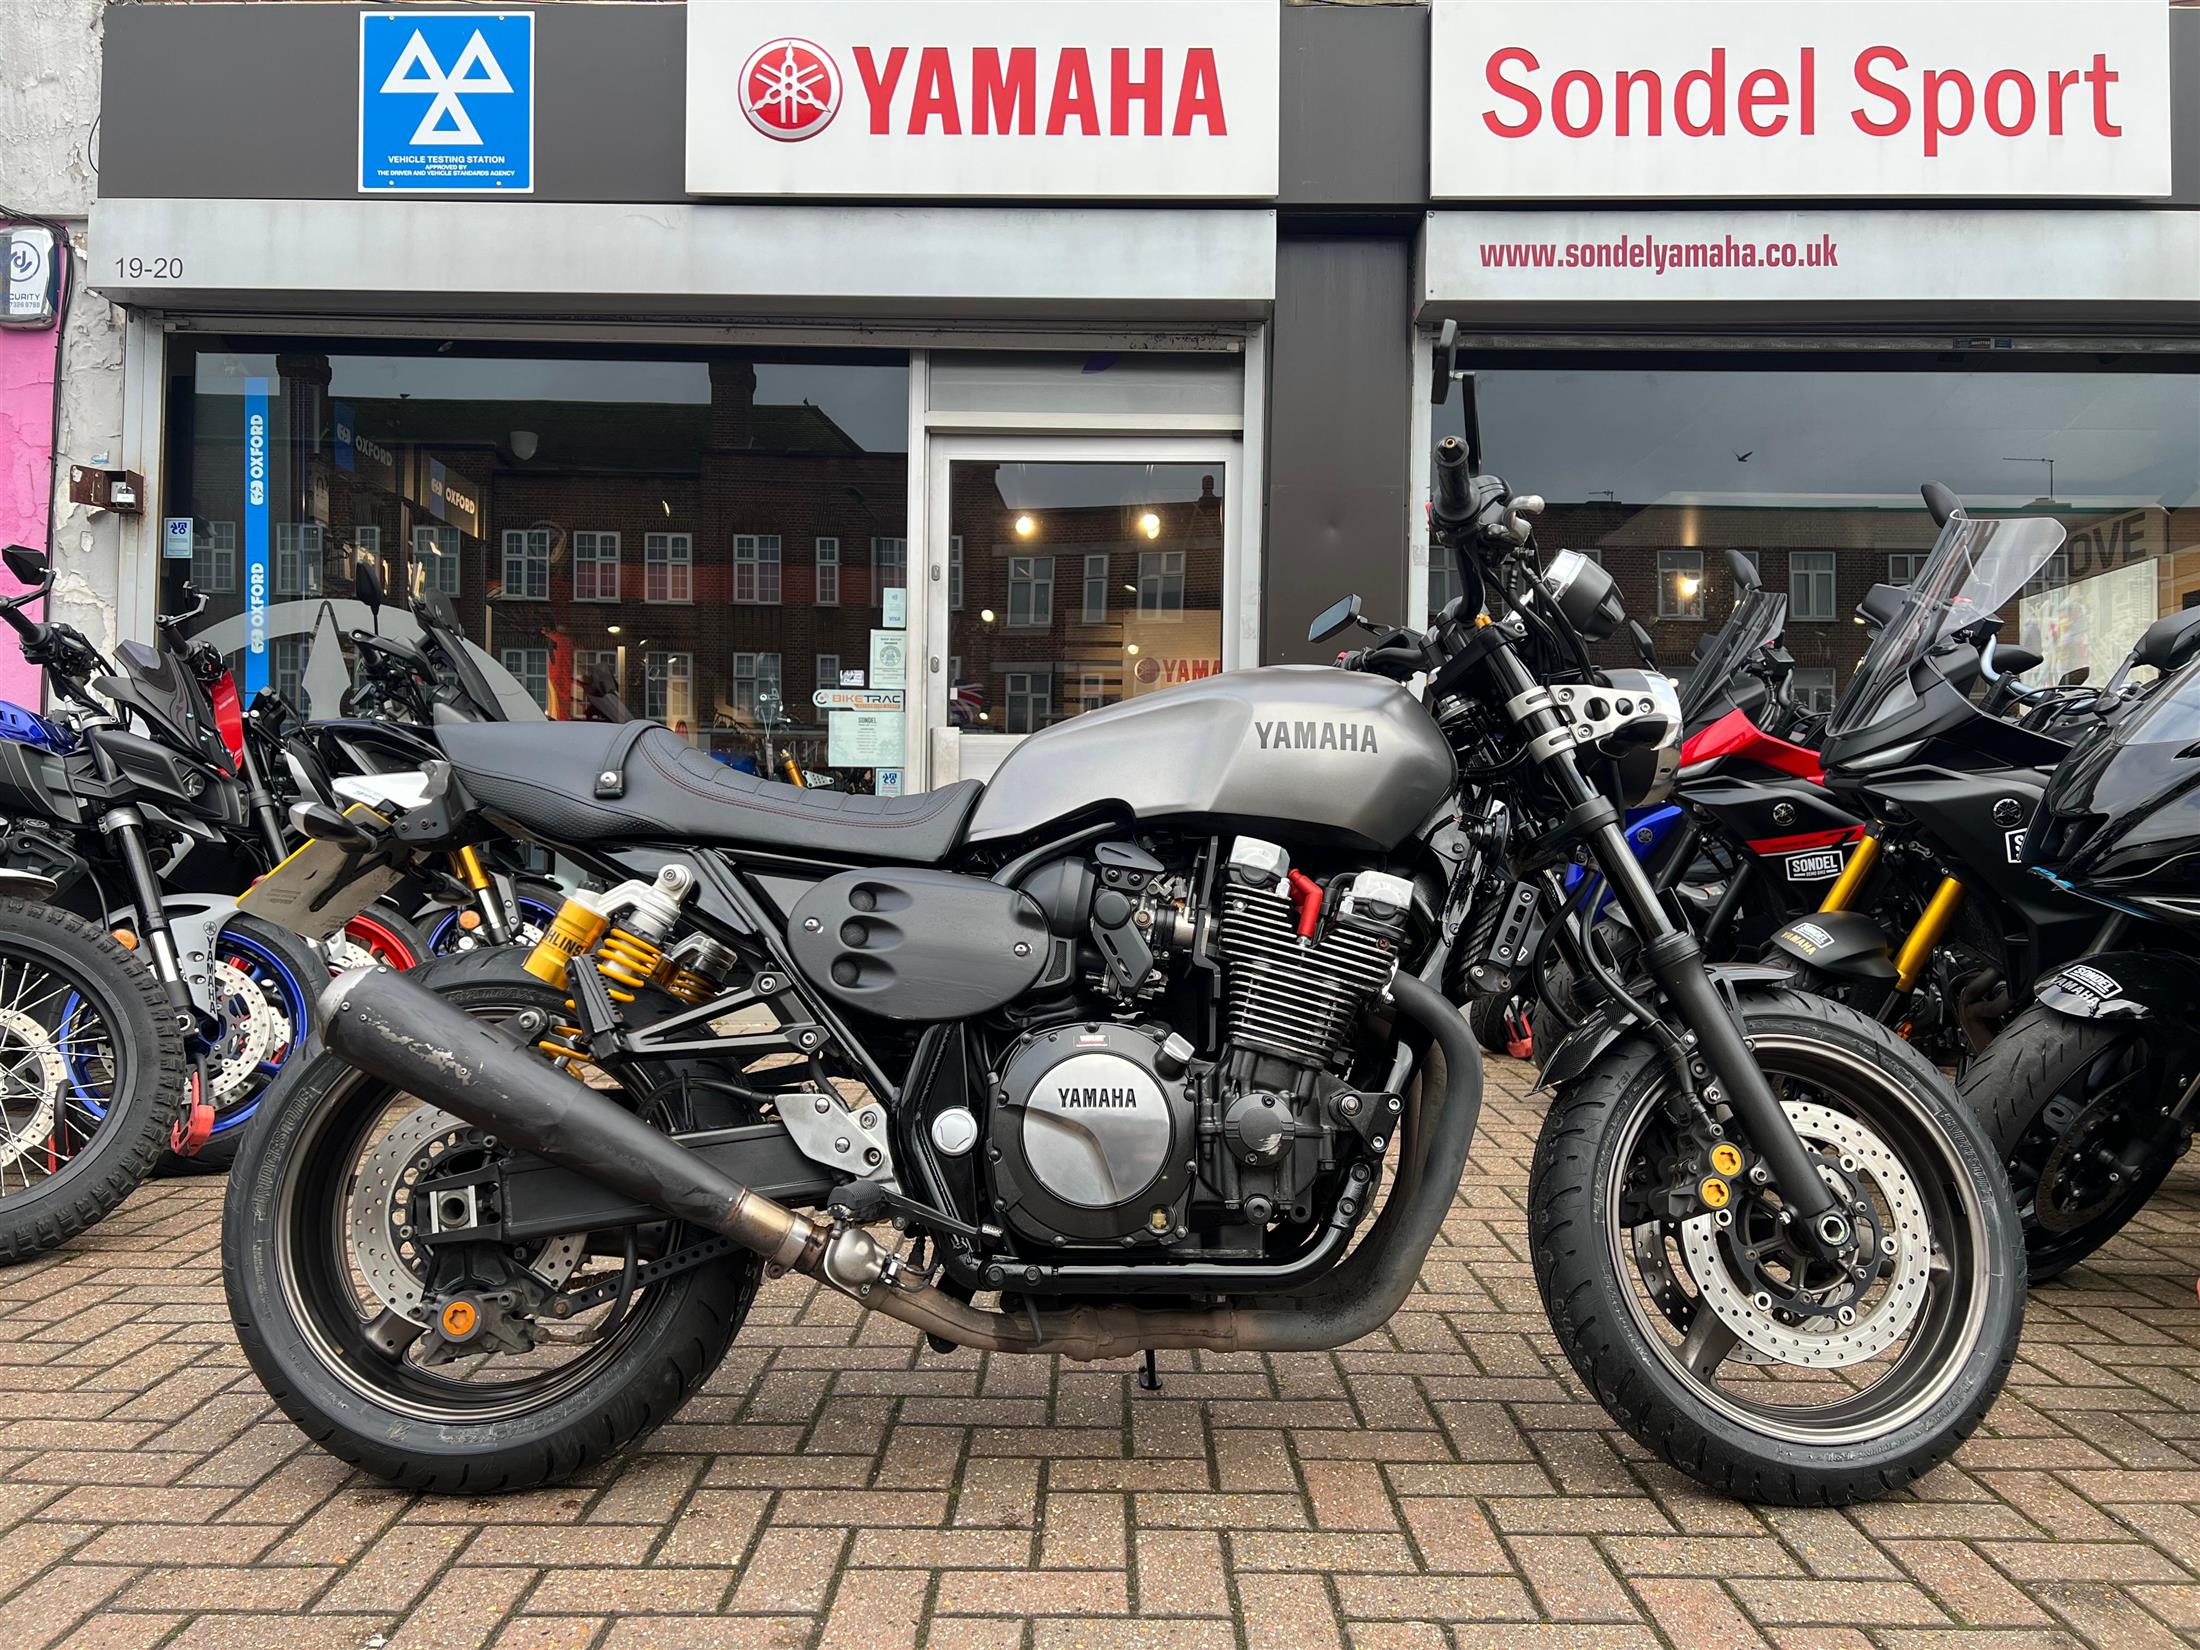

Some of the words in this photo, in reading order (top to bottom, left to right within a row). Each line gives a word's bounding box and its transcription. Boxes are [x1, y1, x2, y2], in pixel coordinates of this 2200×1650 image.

[851, 47, 1228, 136] YAMAHA
[1482, 46, 1816, 138] Sondel
[1850, 45, 2123, 158] Sport
[388, 155, 426, 164] VEHICLE
[427, 155, 465, 164] TESTING
[466, 155, 505, 164] STATION
[115, 258, 183, 280] 19-20
[1480, 233, 1838, 276] www.sondelyamaha.co.uk
[250, 414, 265, 479] OXFORD
[355, 434, 393, 467] OXFORD
[445, 487, 475, 515] OXFORD
[250, 562, 265, 627] OXFORD
[832, 694, 901, 704] BIKETRAC
[1254, 721, 1379, 754] YAMAHA
[1792, 855, 1838, 873] SONDEL
[1780, 931, 1818, 956] YAMAHA
[206, 936, 217, 1015] YAMAHA
[2073, 967, 2114, 992] SONDEL
[1057, 1087, 1138, 1109] YAMAHA
